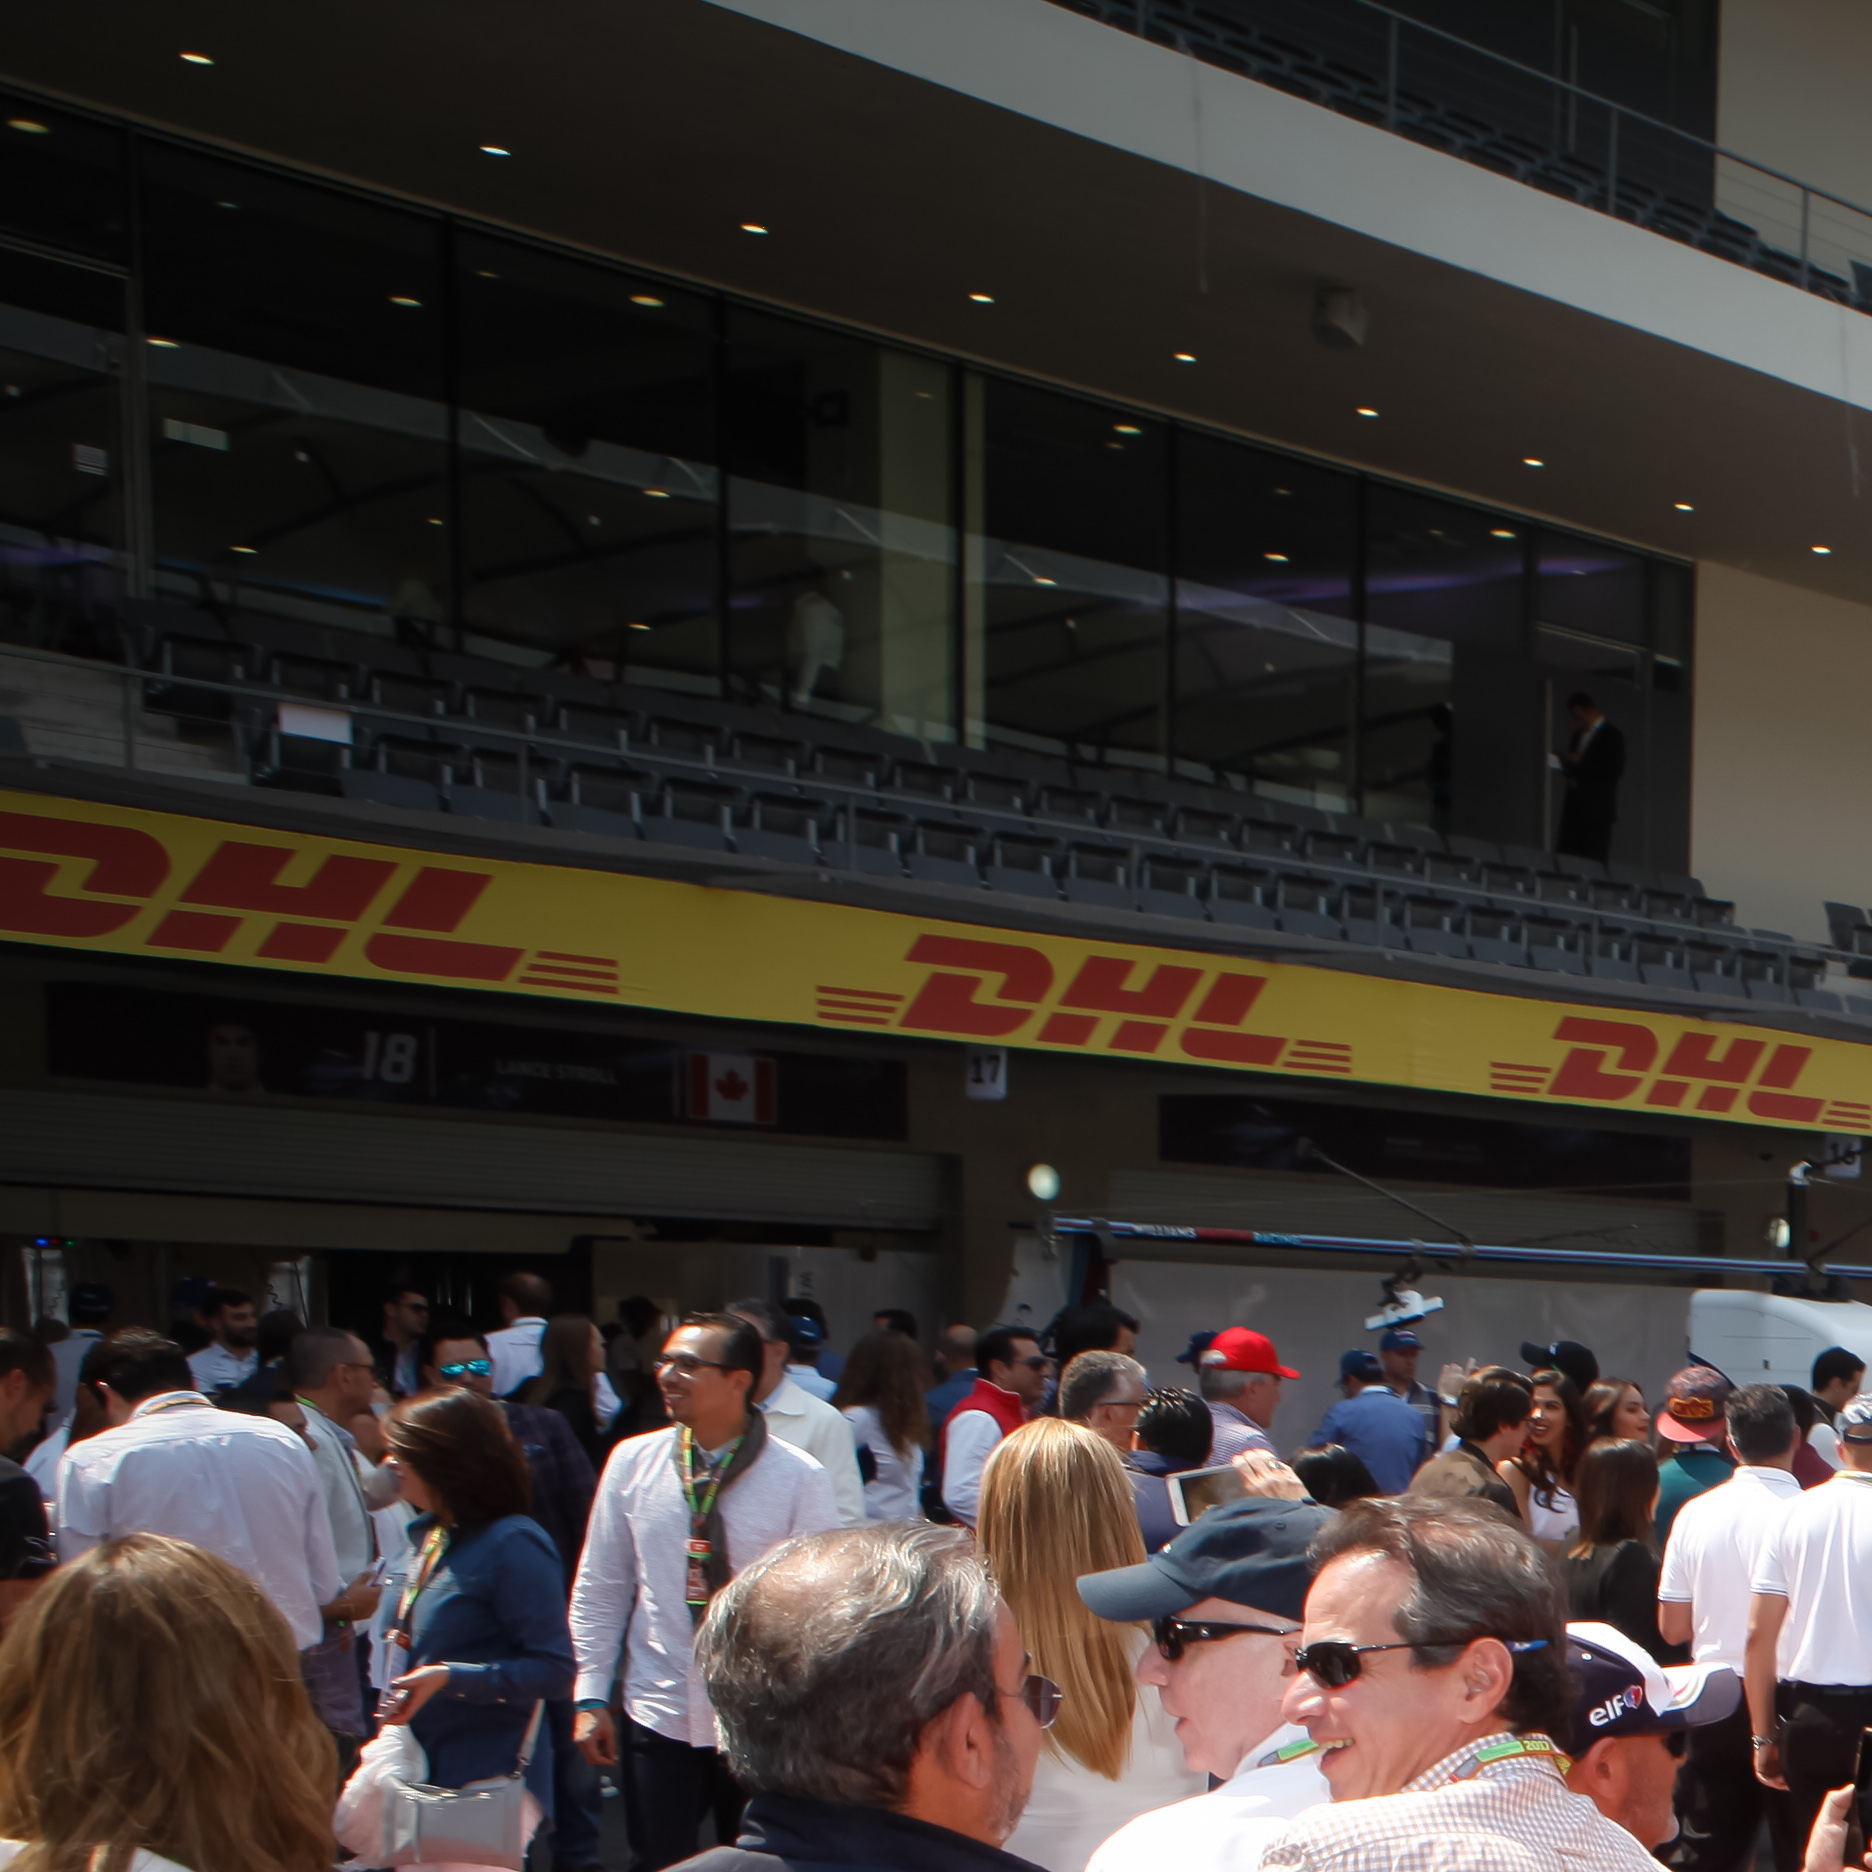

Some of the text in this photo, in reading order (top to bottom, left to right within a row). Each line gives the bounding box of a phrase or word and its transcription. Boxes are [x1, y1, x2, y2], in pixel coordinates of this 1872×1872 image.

[0, 810, 525, 984] DHL
[900, 935, 1288, 1066] DHL
[362, 1029, 418, 1084] 18
[971, 1054, 1001, 1084] 17
[1548, 1016, 1825, 1123] DHL
[1589, 1694, 1625, 1727] elf
